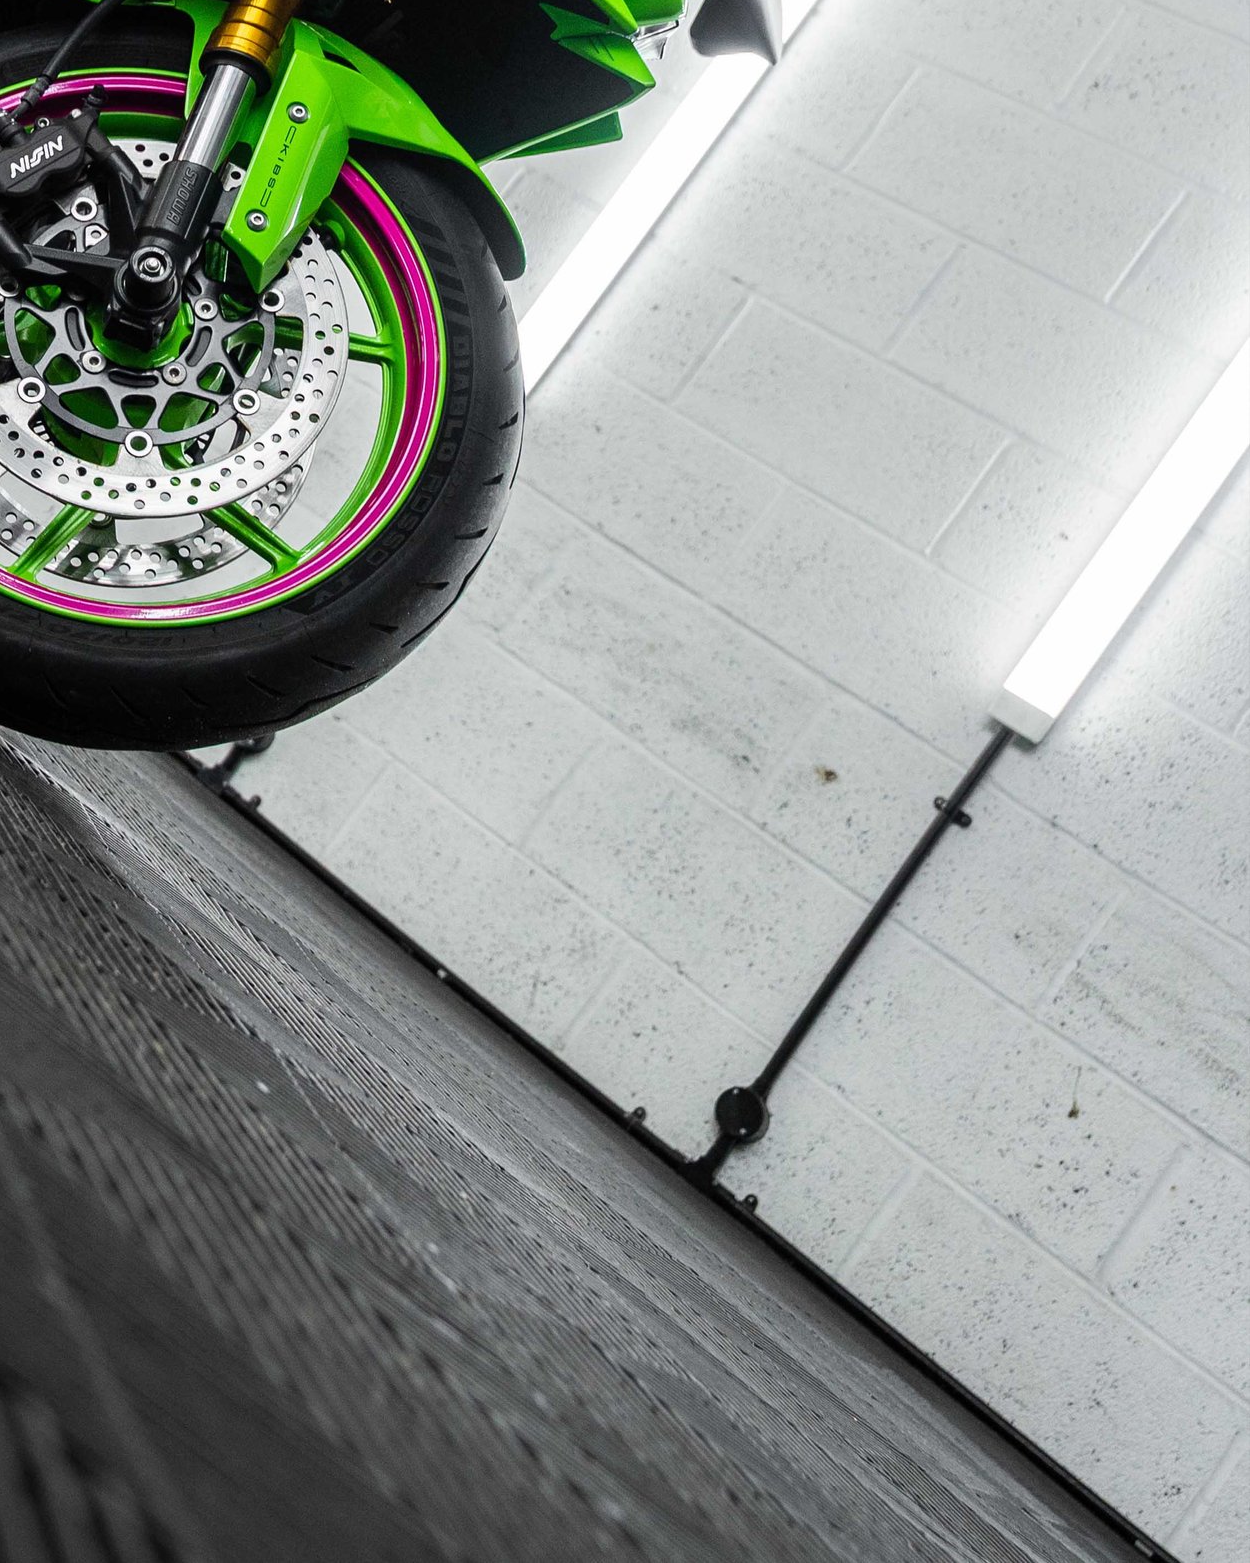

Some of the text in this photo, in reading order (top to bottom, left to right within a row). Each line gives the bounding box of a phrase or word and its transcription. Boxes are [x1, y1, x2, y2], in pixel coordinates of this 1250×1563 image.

[10, 135, 63, 179] NISSIN
[166, 166, 199, 226] SHOWA
[434, 334, 471, 463] DIABLO
[366, 473, 444, 566] ROSSO
